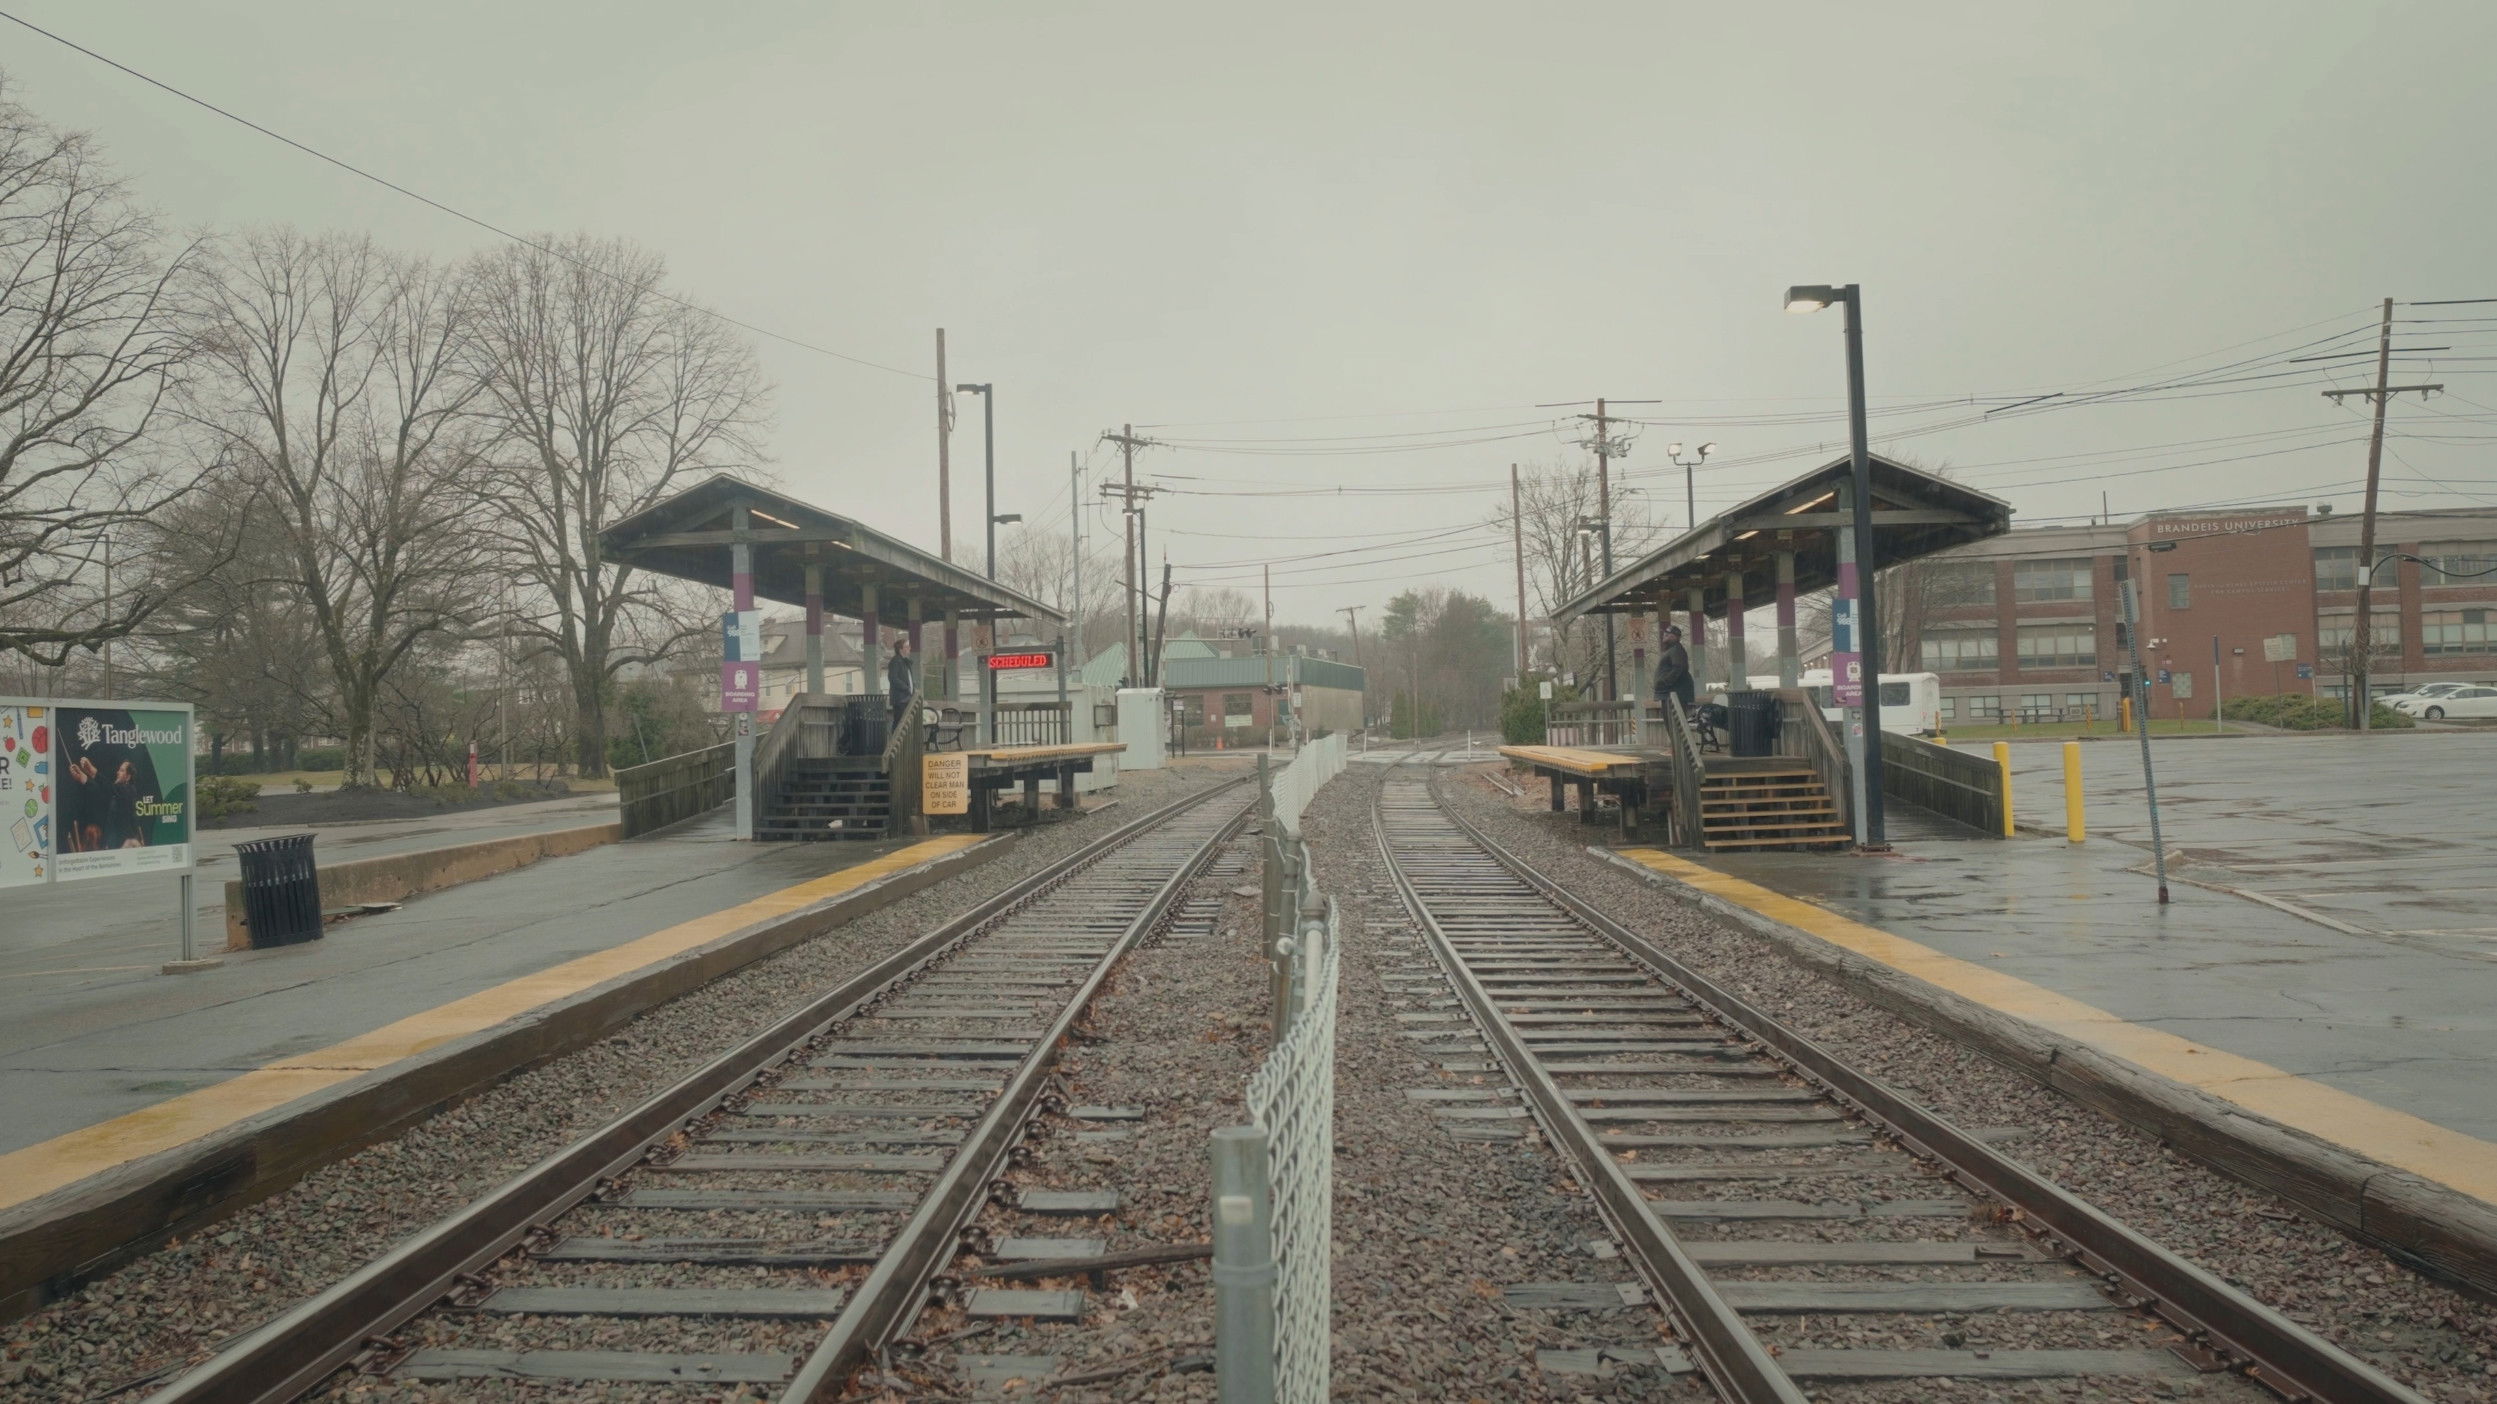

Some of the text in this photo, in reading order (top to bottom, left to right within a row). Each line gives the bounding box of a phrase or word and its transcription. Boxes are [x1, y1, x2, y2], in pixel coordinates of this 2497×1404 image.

[2157, 518, 2300, 534] BRANDEIS UNIVERSITY
[989, 654, 1048, 669] SCHEDULED
[102, 724, 182, 748] Tanglewood
[928, 760, 961, 768] DANGER
[928, 771, 960, 780] WILL NOT
[925, 780, 965, 789] CLEAR MAN
[930, 790, 958, 799] ON SIDE
[143, 796, 154, 804] LET
[942, 800, 956, 808] CAR
[135, 801, 183, 816] Summer
